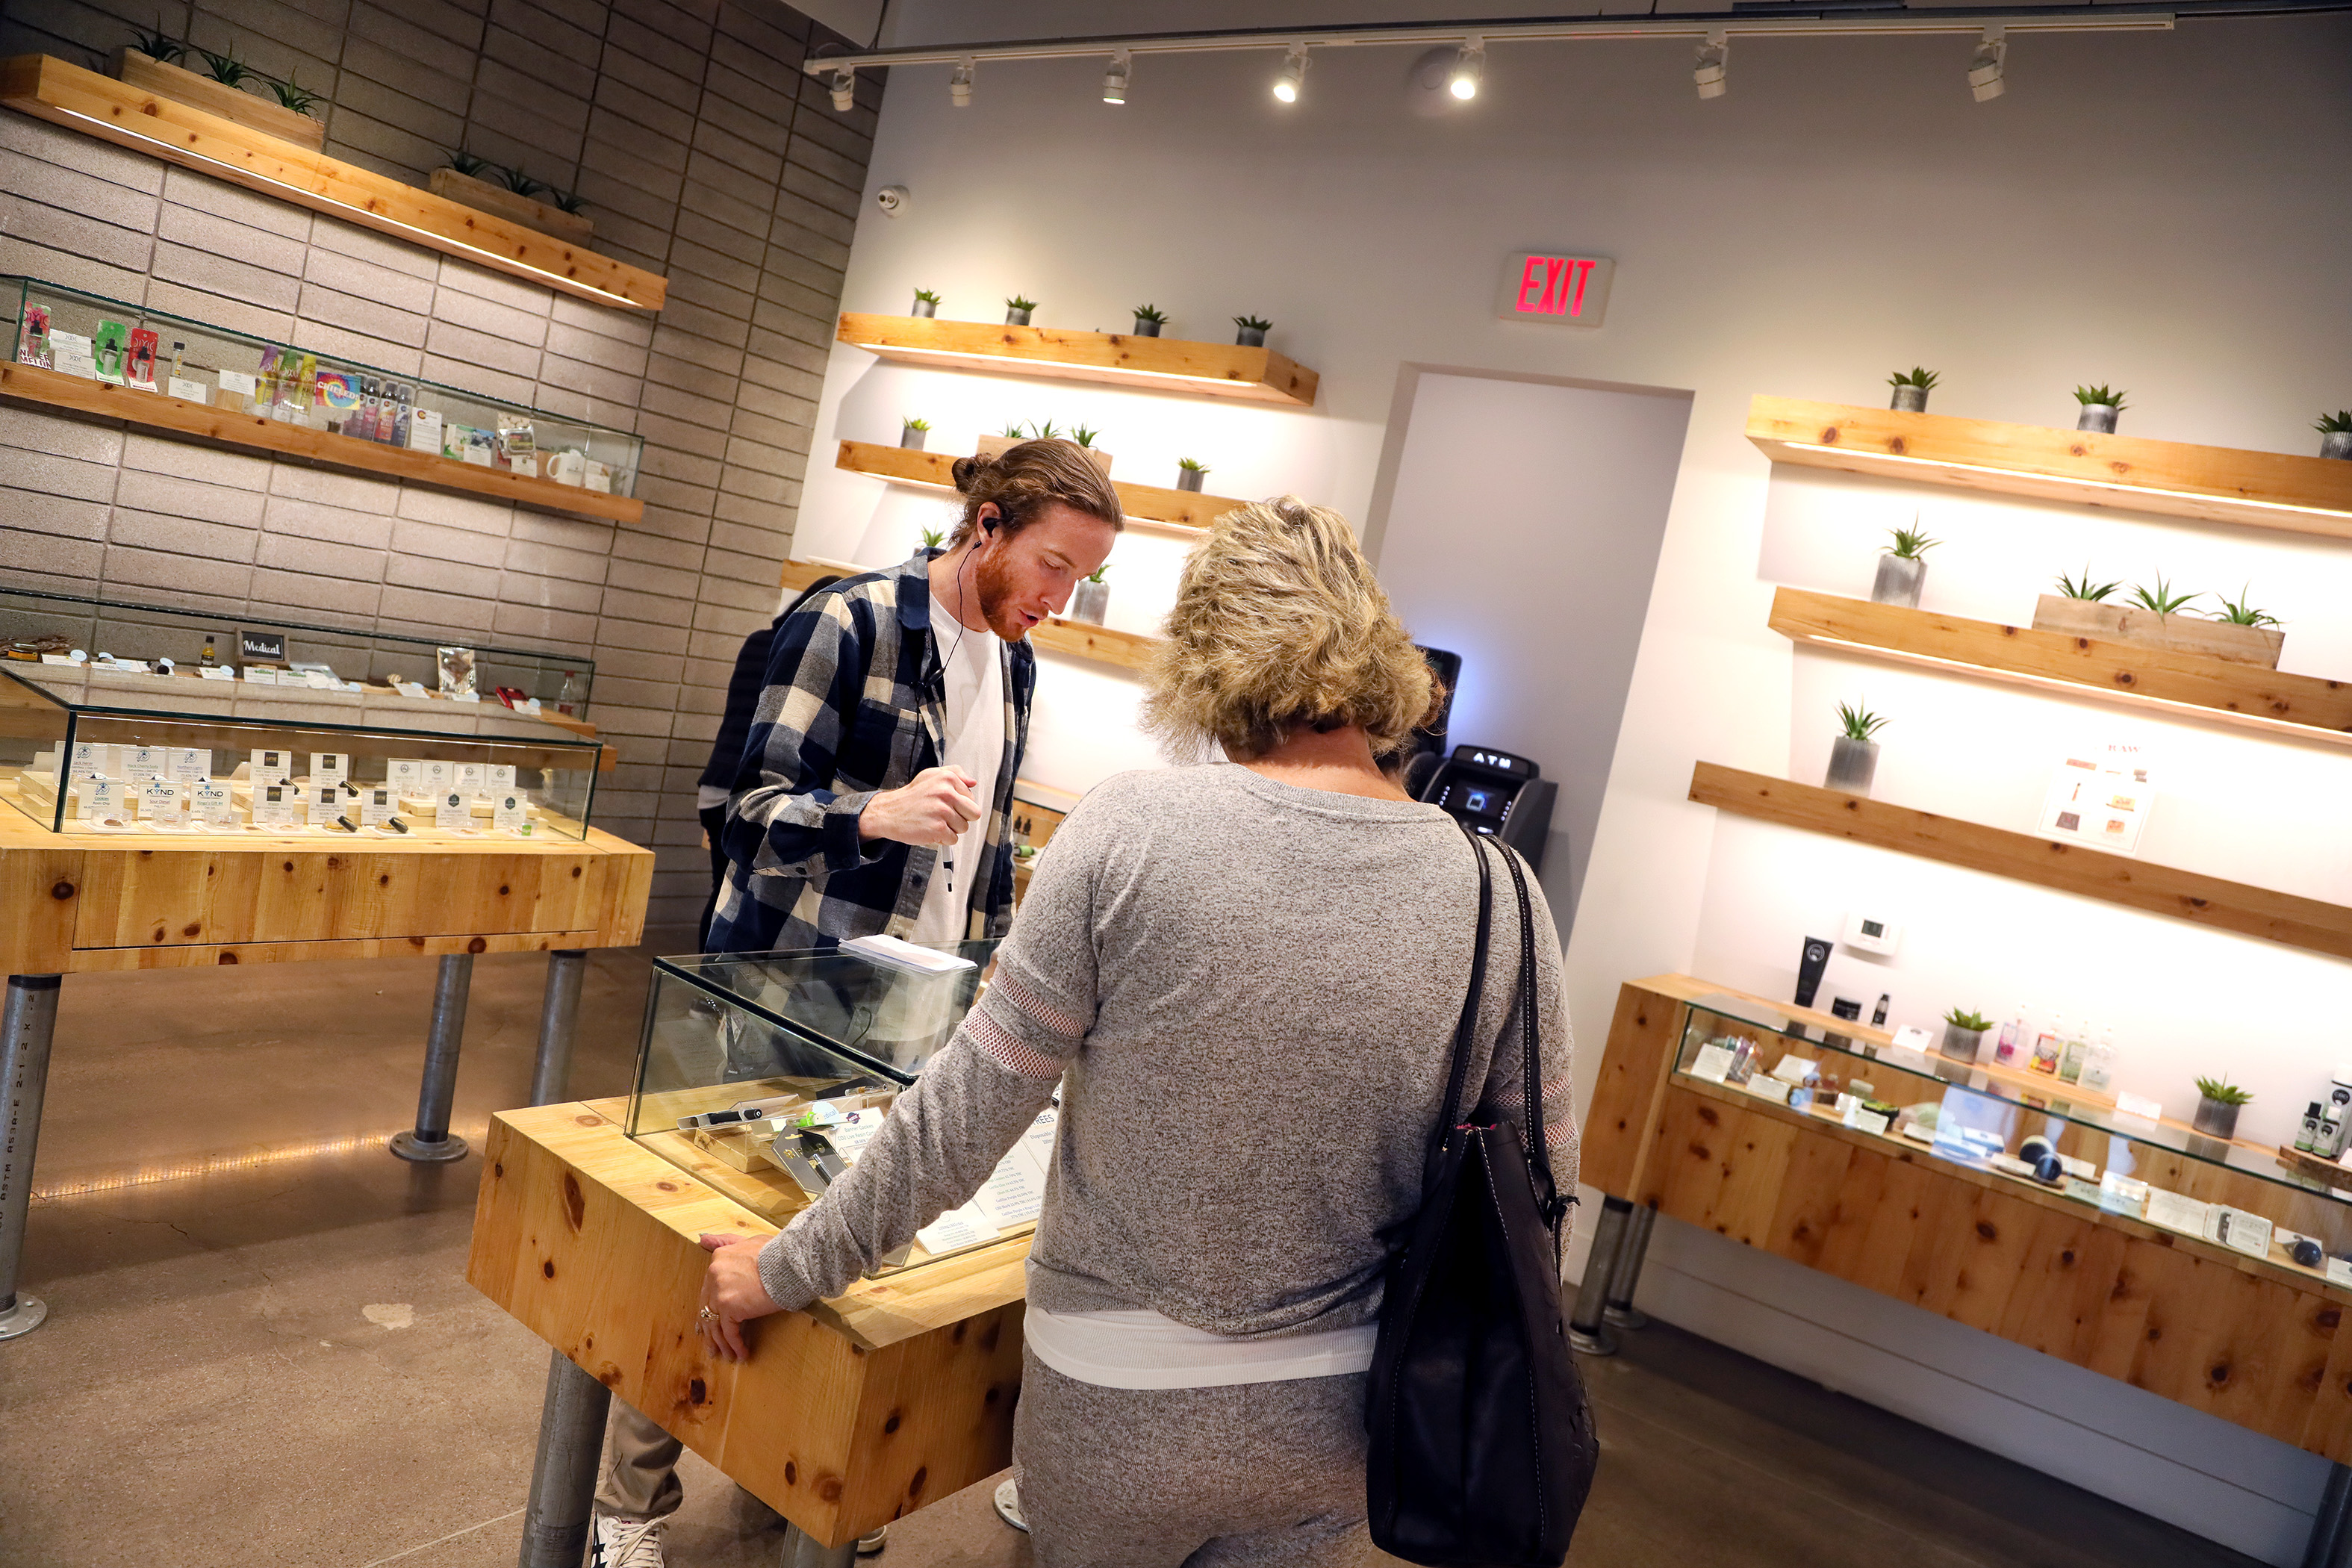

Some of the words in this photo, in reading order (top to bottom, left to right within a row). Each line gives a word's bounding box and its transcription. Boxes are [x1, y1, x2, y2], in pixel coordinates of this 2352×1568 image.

[1515, 255, 1596, 317] EXIT
[317, 381, 359, 400] CHILLED!
[243, 640, 280, 655] Medical
[1472, 752, 1511, 769] ATM
[824, 1108, 837, 1119] dical
[1030, 1130, 1051, 1139] Disposable
[0, 1163, 11, 1201] ASTM
